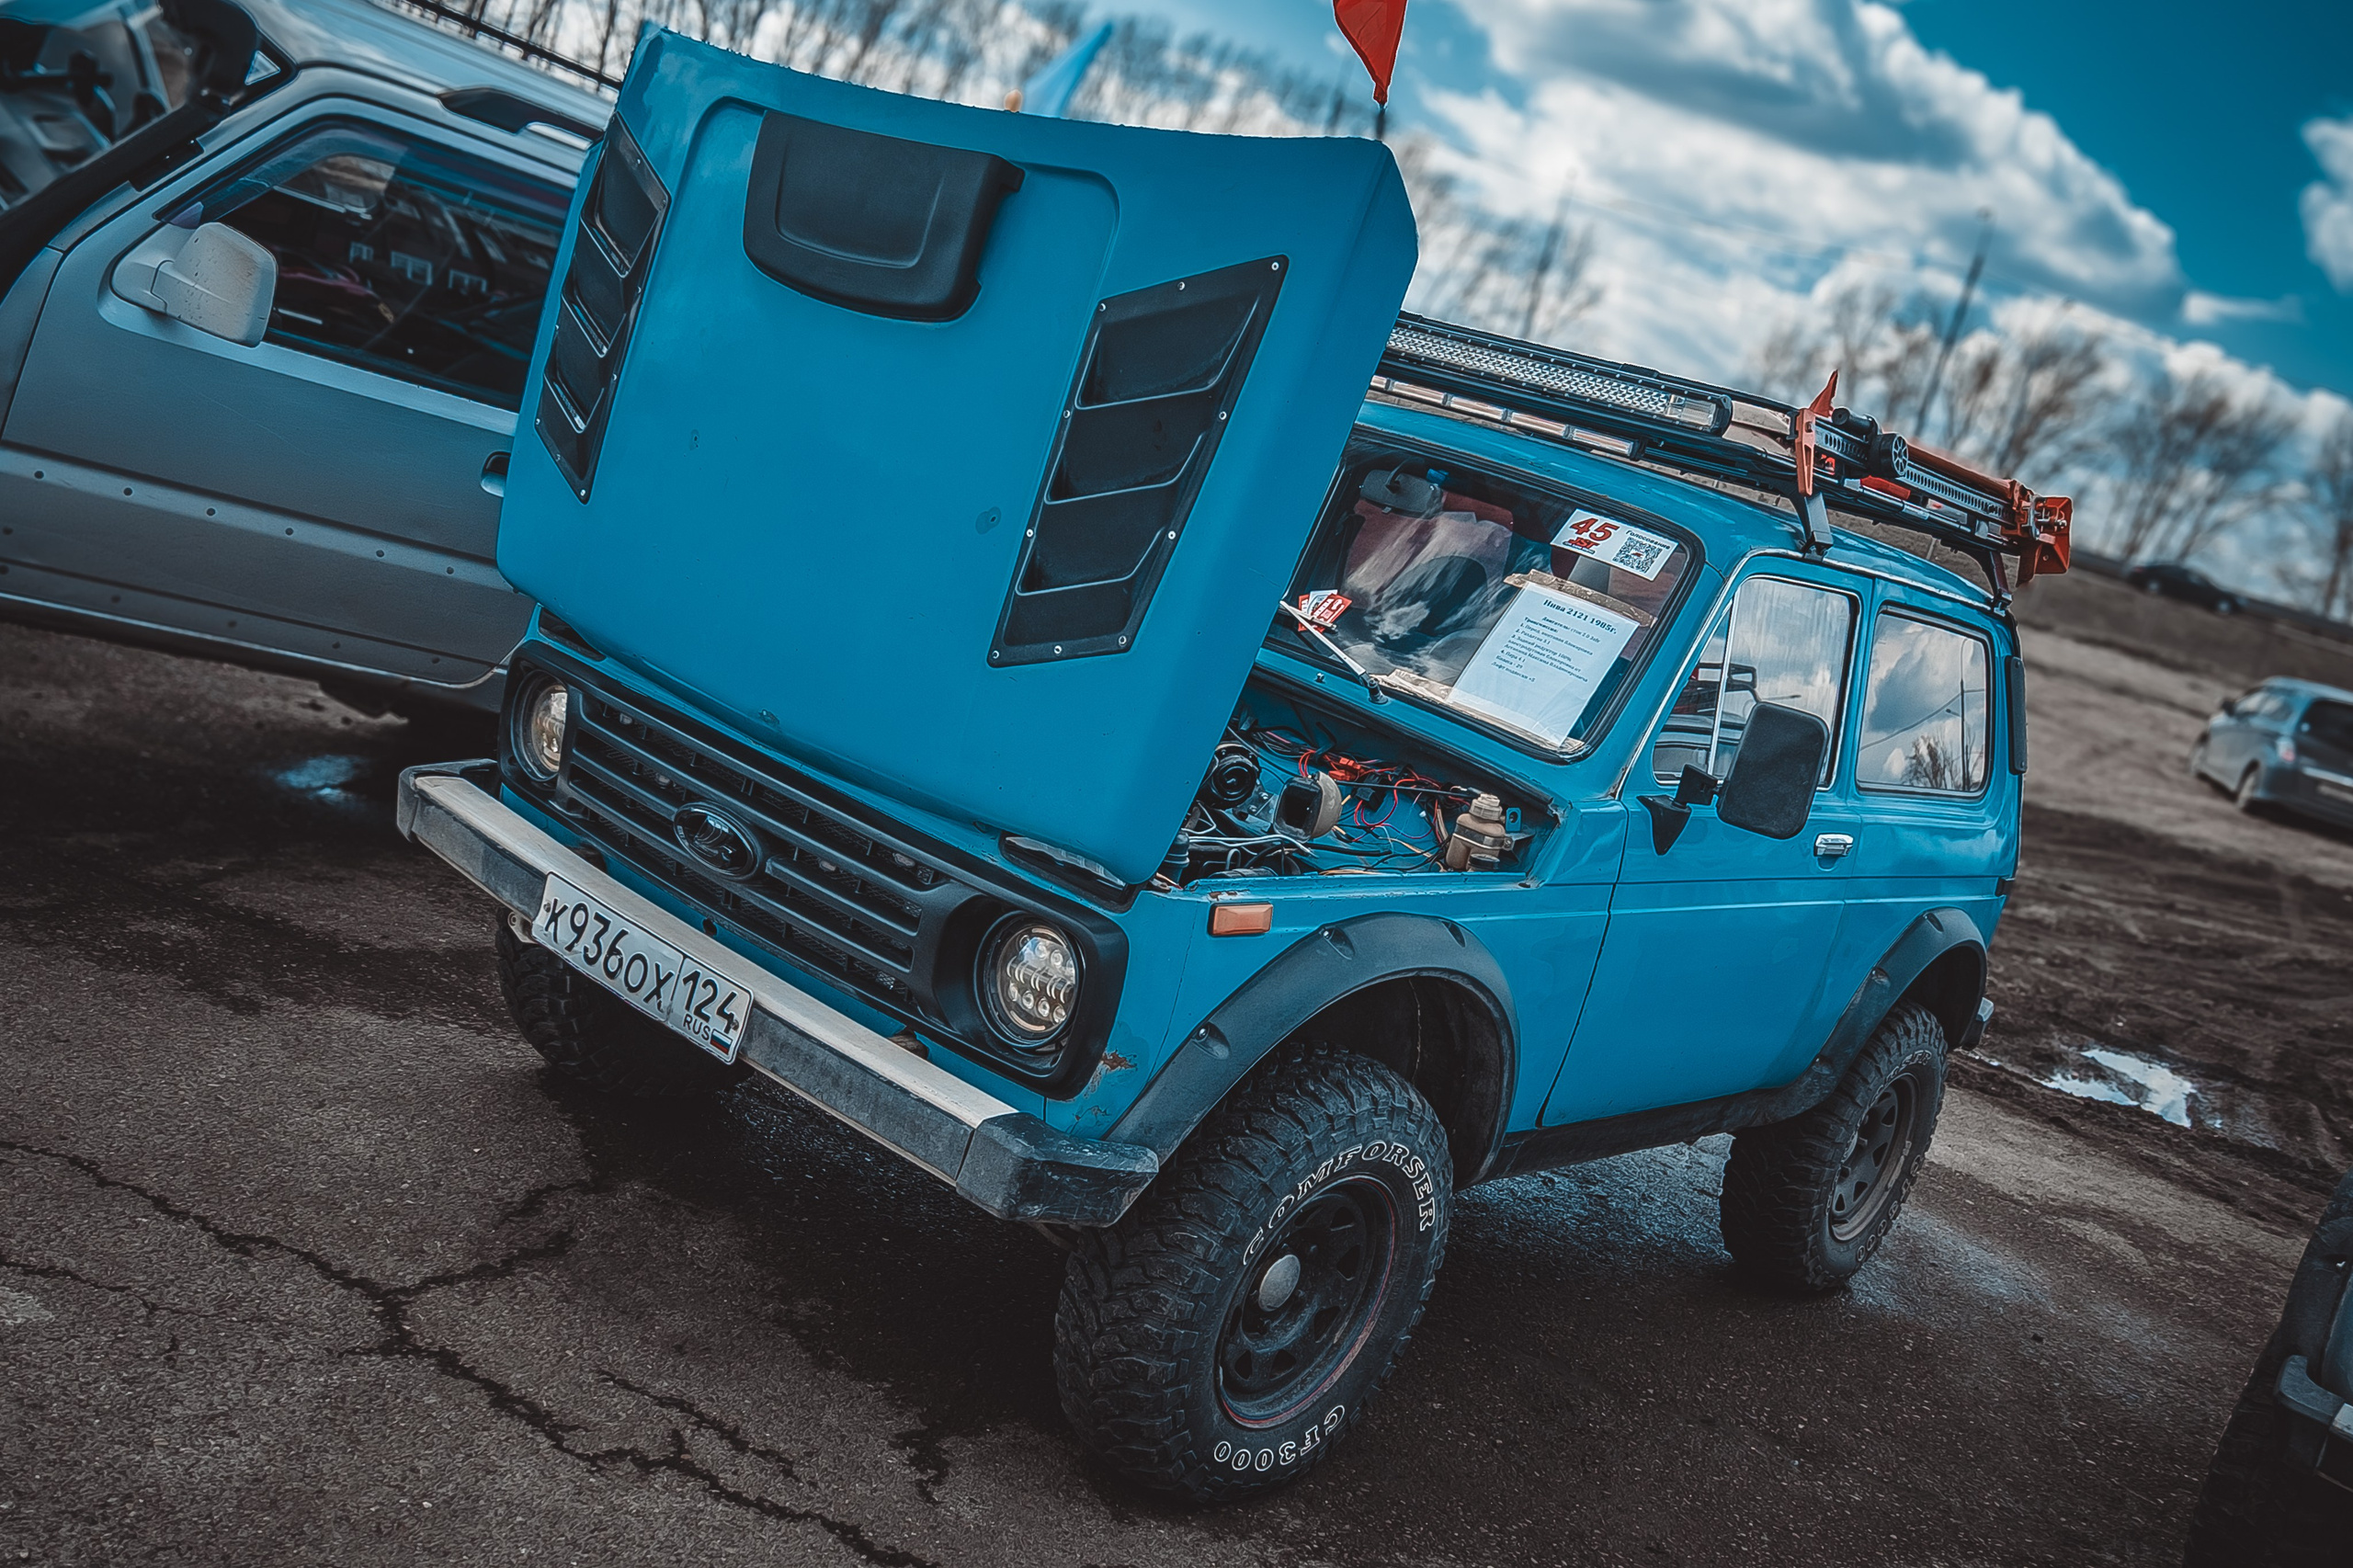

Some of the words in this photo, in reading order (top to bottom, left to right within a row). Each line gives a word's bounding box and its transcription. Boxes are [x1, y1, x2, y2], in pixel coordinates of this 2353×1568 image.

[1570, 518, 1620, 540] 45
[1625, 529, 1671, 550] Голосование
[1543, 599, 1565, 611] Нива
[1566, 608, 1588, 620] 2121
[682, 970, 738, 1034] 124
[683, 1013, 711, 1041] RUS
[1243, 1141, 1437, 1267] COMFORSER
[1214, 1403, 1346, 1472] CF3000
